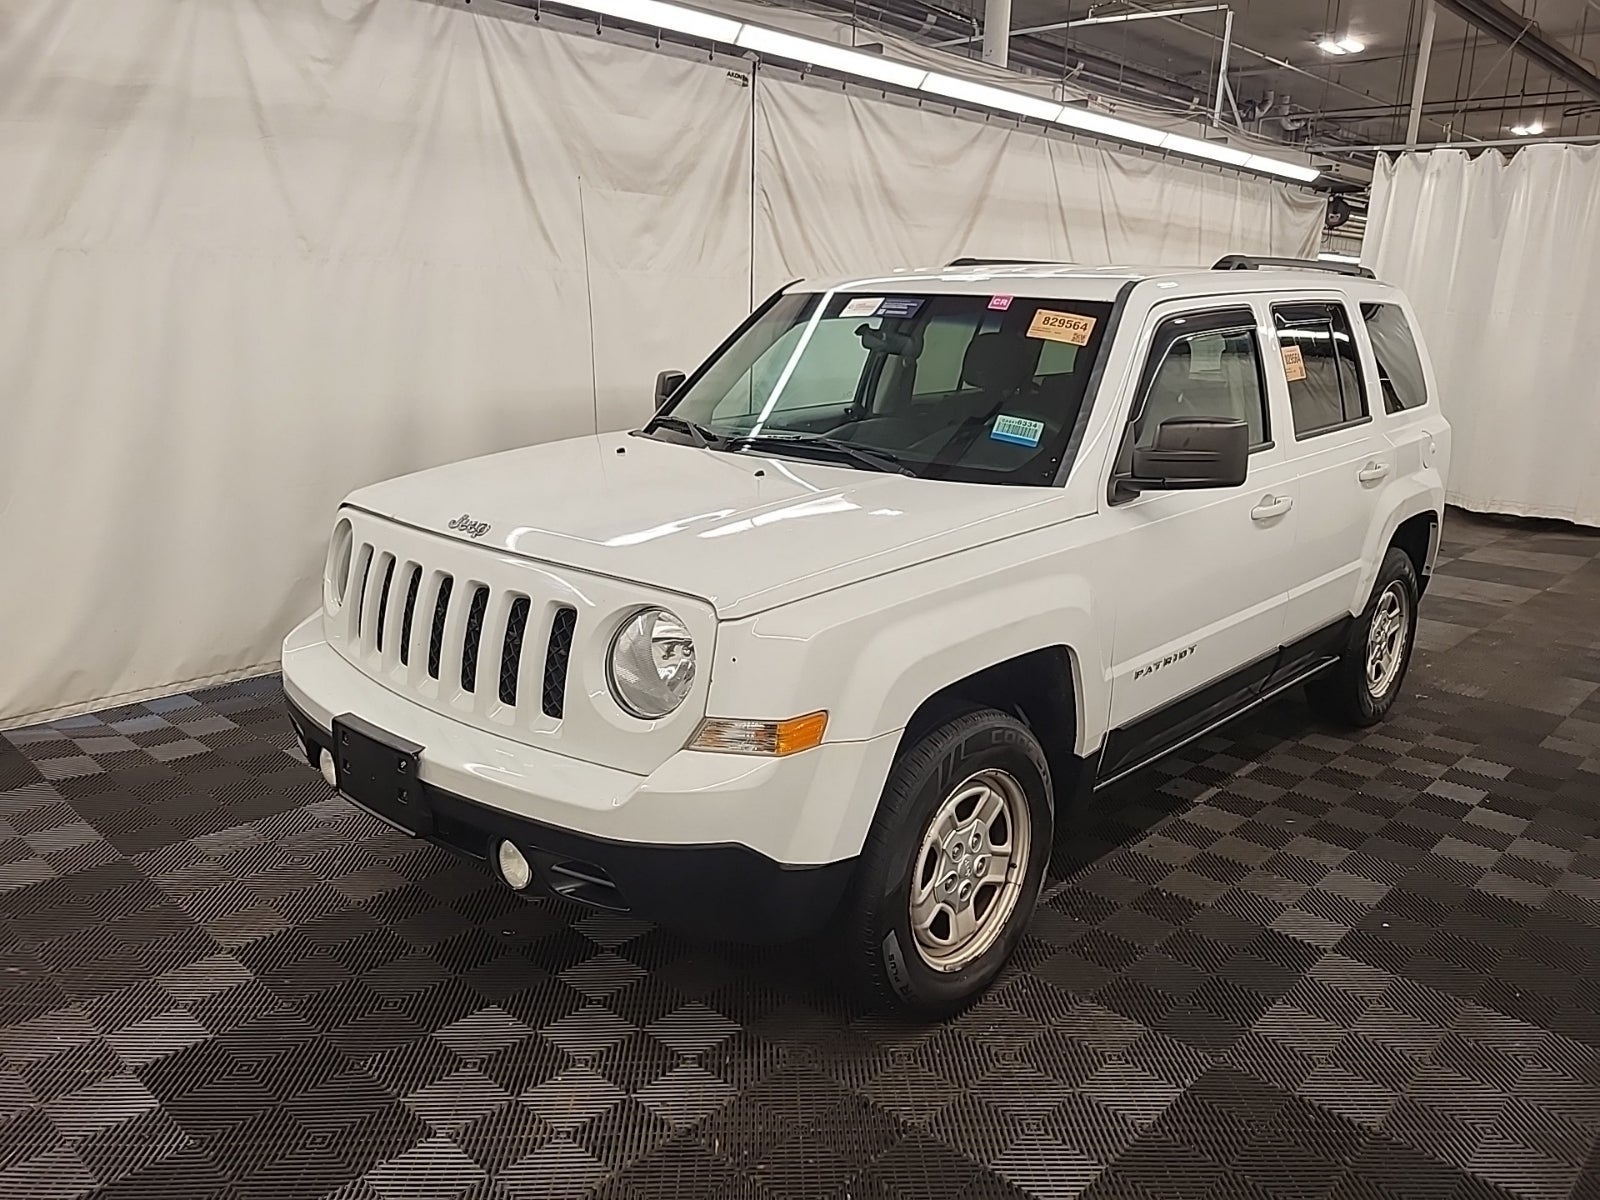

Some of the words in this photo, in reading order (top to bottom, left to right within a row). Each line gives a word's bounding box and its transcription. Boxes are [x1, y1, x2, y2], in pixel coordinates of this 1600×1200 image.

[993, 298, 1008, 306] CR
[1042, 316, 1088, 332] 829564
[448, 514, 491, 538] Jeep
[1134, 644, 1197, 680] PATRIOT
